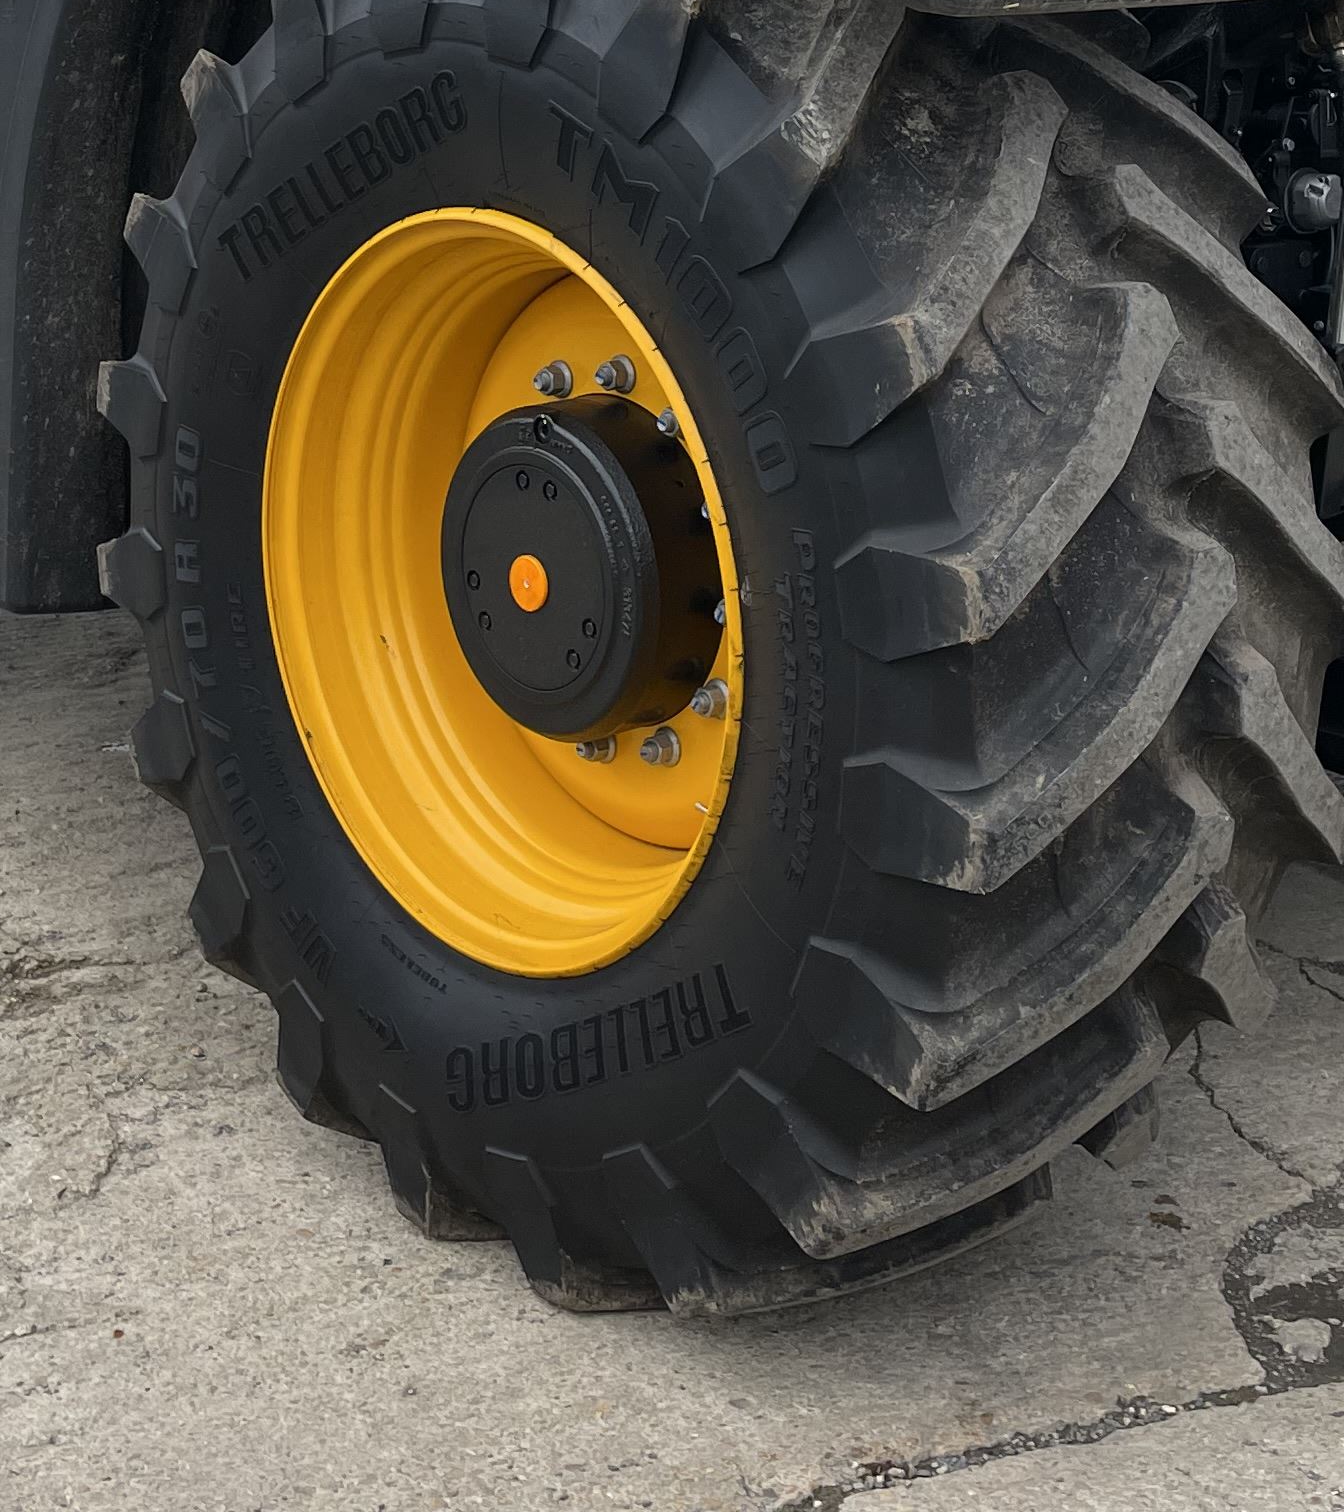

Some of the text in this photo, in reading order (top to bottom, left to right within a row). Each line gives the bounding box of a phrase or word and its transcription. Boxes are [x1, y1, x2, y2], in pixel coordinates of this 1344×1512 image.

[217, 69, 469, 282] TRELLEBORG
[548, 99, 799, 493] TM1000
[172, 424, 200, 519] 30
[445, 961, 754, 1114] TRELLEBORG
